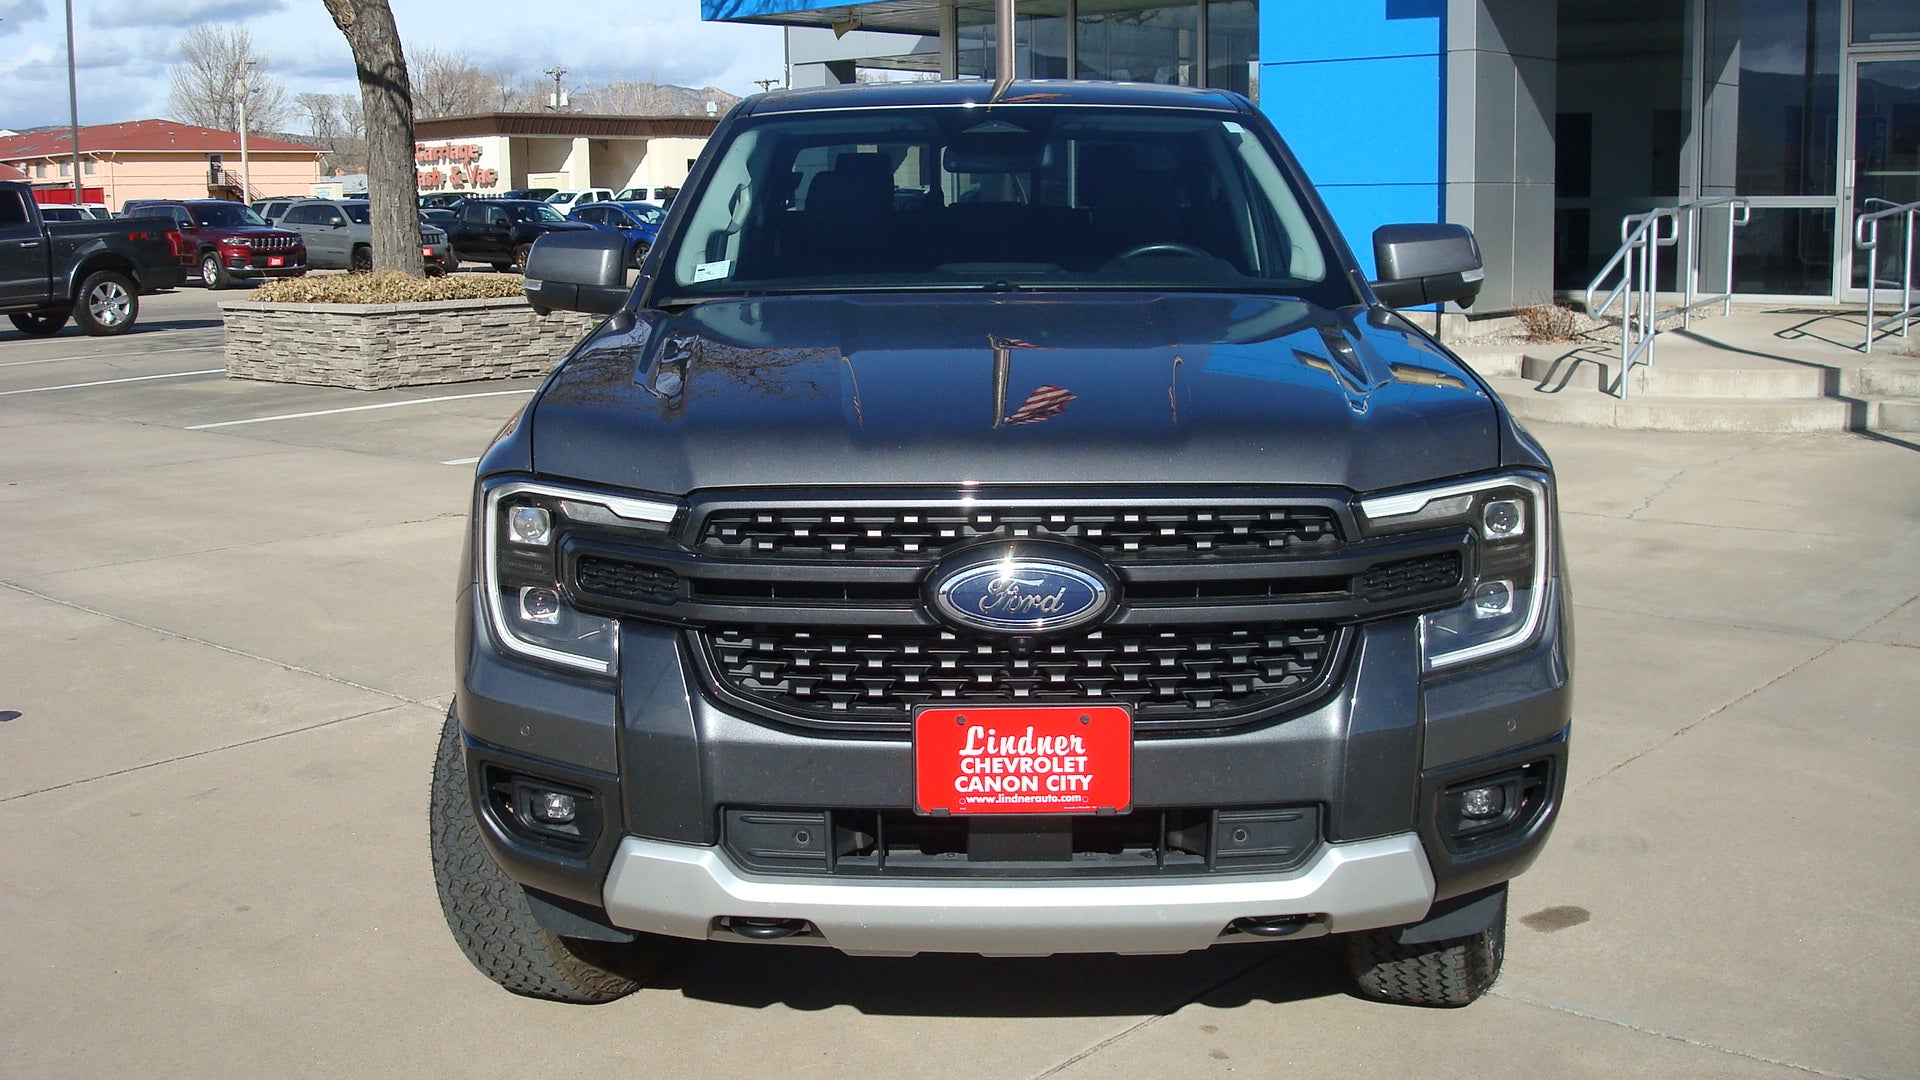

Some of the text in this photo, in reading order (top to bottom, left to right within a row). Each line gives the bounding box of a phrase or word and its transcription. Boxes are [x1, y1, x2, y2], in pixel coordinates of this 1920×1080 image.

[415, 142, 480, 164] Carriage
[416, 164, 497, 186] ash & Vac
[979, 577, 1065, 614] Ford
[959, 726, 1086, 756] Lindner
[960, 756, 1088, 774] CHEVROLET
[954, 775, 1093, 793] CANON CITY
[965, 793, 1082, 804] www.lindnerauto.com
